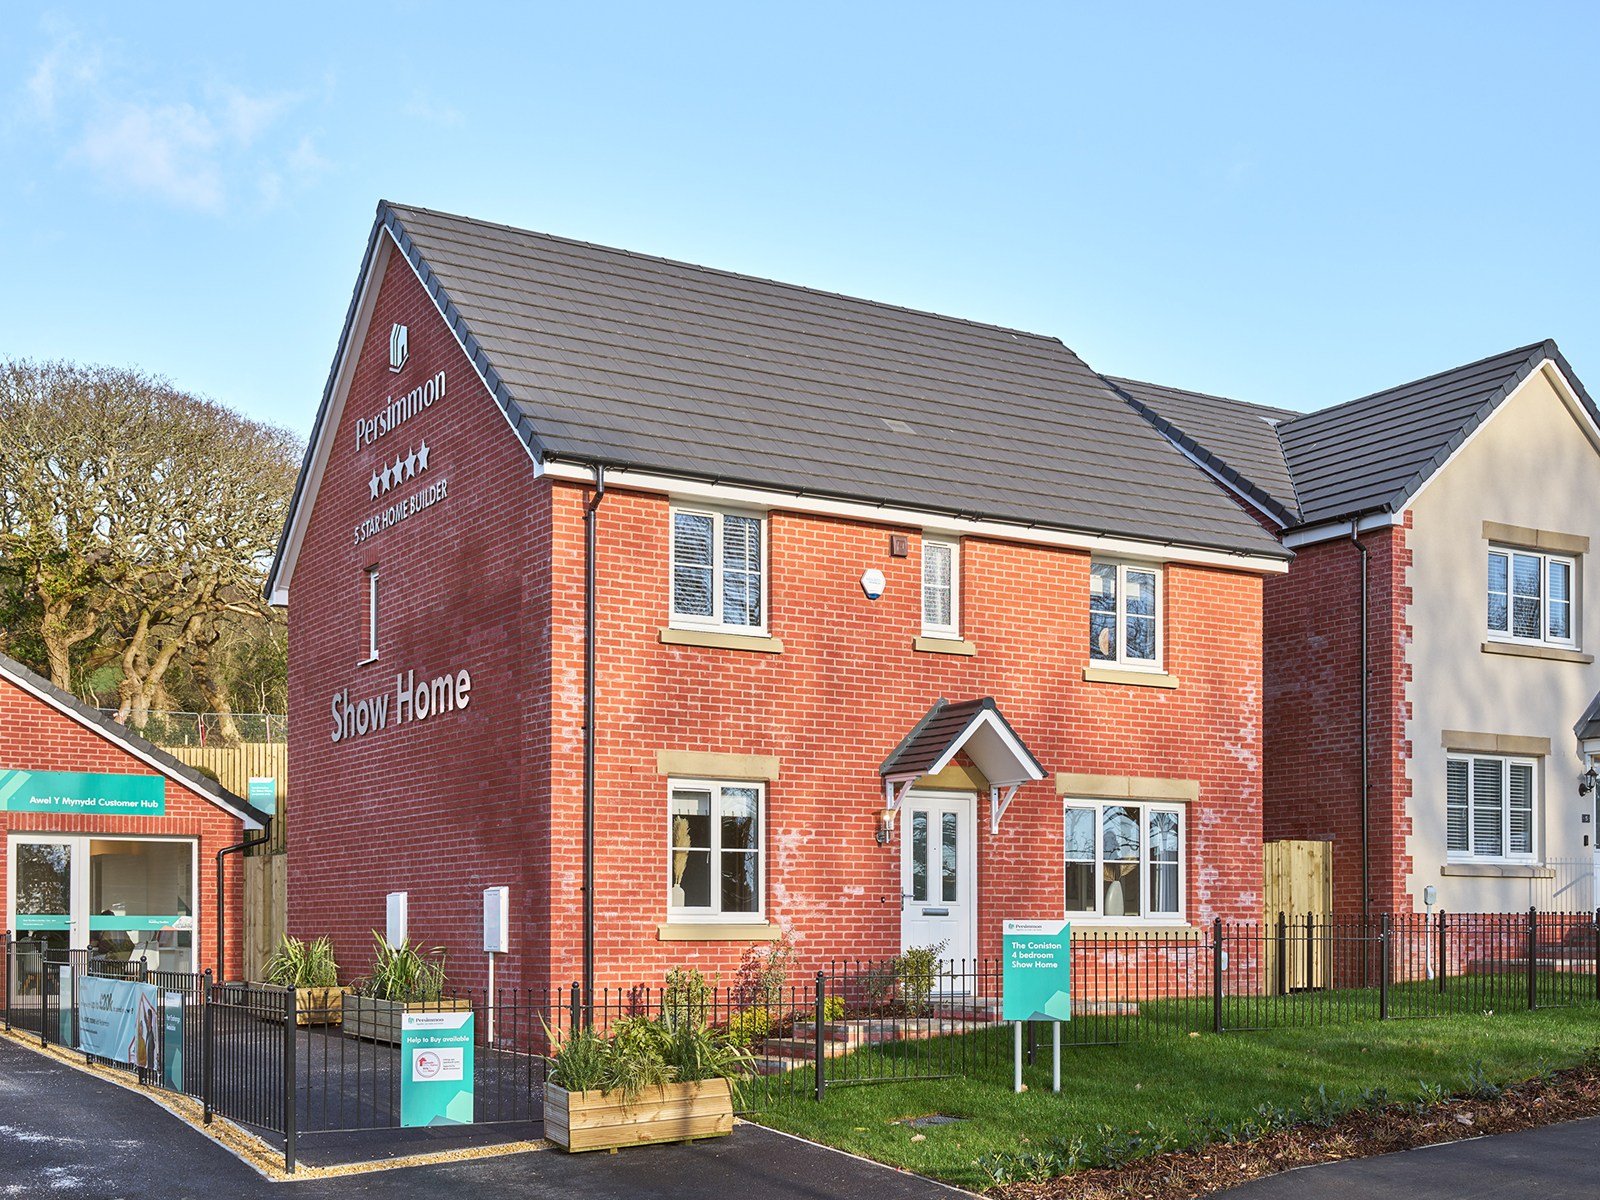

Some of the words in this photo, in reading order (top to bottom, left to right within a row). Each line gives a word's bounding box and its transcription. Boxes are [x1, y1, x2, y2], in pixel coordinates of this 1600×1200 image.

[356, 370, 446, 452] Persimmon
[354, 526, 360, 545] 5
[361, 515, 380, 541] STAR
[382, 500, 408, 530] HOME
[410, 478, 448, 515] BUILDER
[331, 687, 389, 742] Show
[396, 669, 471, 724] Home
[29, 796, 52, 805] Awel
[54, 797, 61, 805] Y
[62, 797, 96, 808] Mynydd
[98, 798, 138, 808] Customer
[140, 799, 159, 808] Hub
[1011, 951, 1017, 959] 4
[1019, 951, 1054, 959] bedroom
